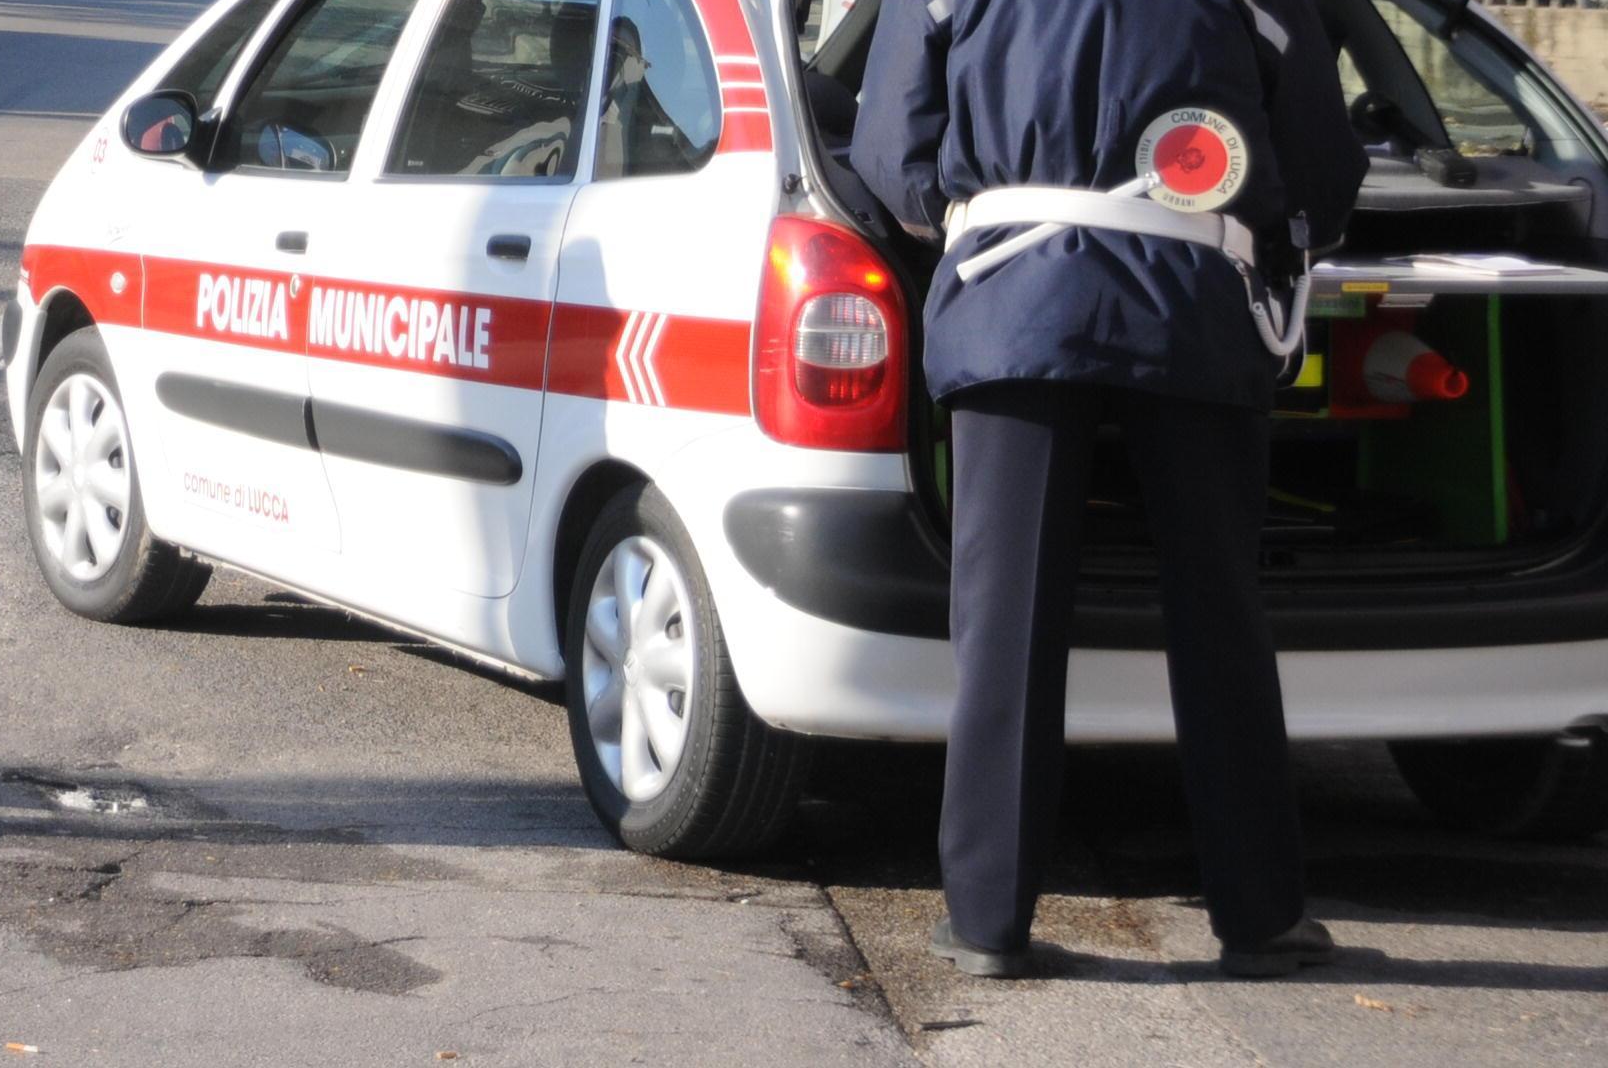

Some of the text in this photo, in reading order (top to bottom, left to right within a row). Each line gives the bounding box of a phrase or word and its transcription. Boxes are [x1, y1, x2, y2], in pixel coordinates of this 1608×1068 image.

[1170, 110, 1242, 195] COMUNE DI LUCCA
[196, 272, 491, 370] POLIZIA MUNICIPALE
[183, 471, 290, 525] comune di LUCCA
